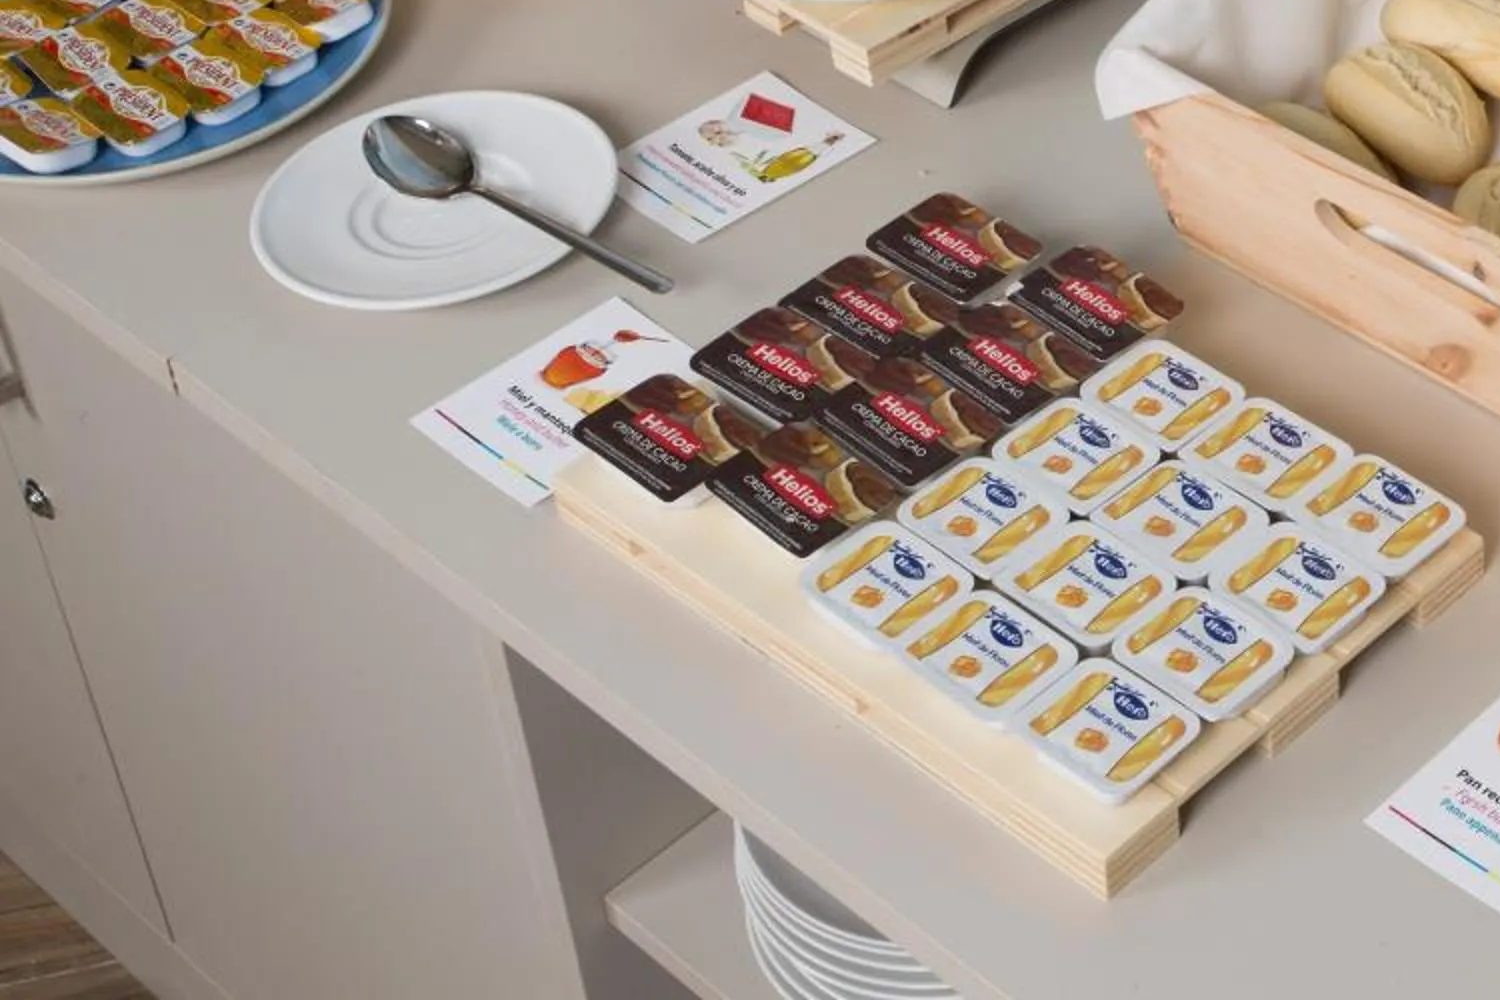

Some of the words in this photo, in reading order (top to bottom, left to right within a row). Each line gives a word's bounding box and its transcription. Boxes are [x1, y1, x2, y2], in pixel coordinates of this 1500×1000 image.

[928, 228, 982, 265] Helios
[840, 290, 898, 329] Helios
[1066, 281, 1121, 320] Helios
[753, 344, 811, 383] Helios
[975, 340, 1031, 381] Helios
[534, 406, 576, 438] mantequ
[640, 413, 695, 454] Helios
[878, 395, 936, 439] Helios
[771, 468, 827, 514] Helios
[1456, 769, 1482, 791] Pan
